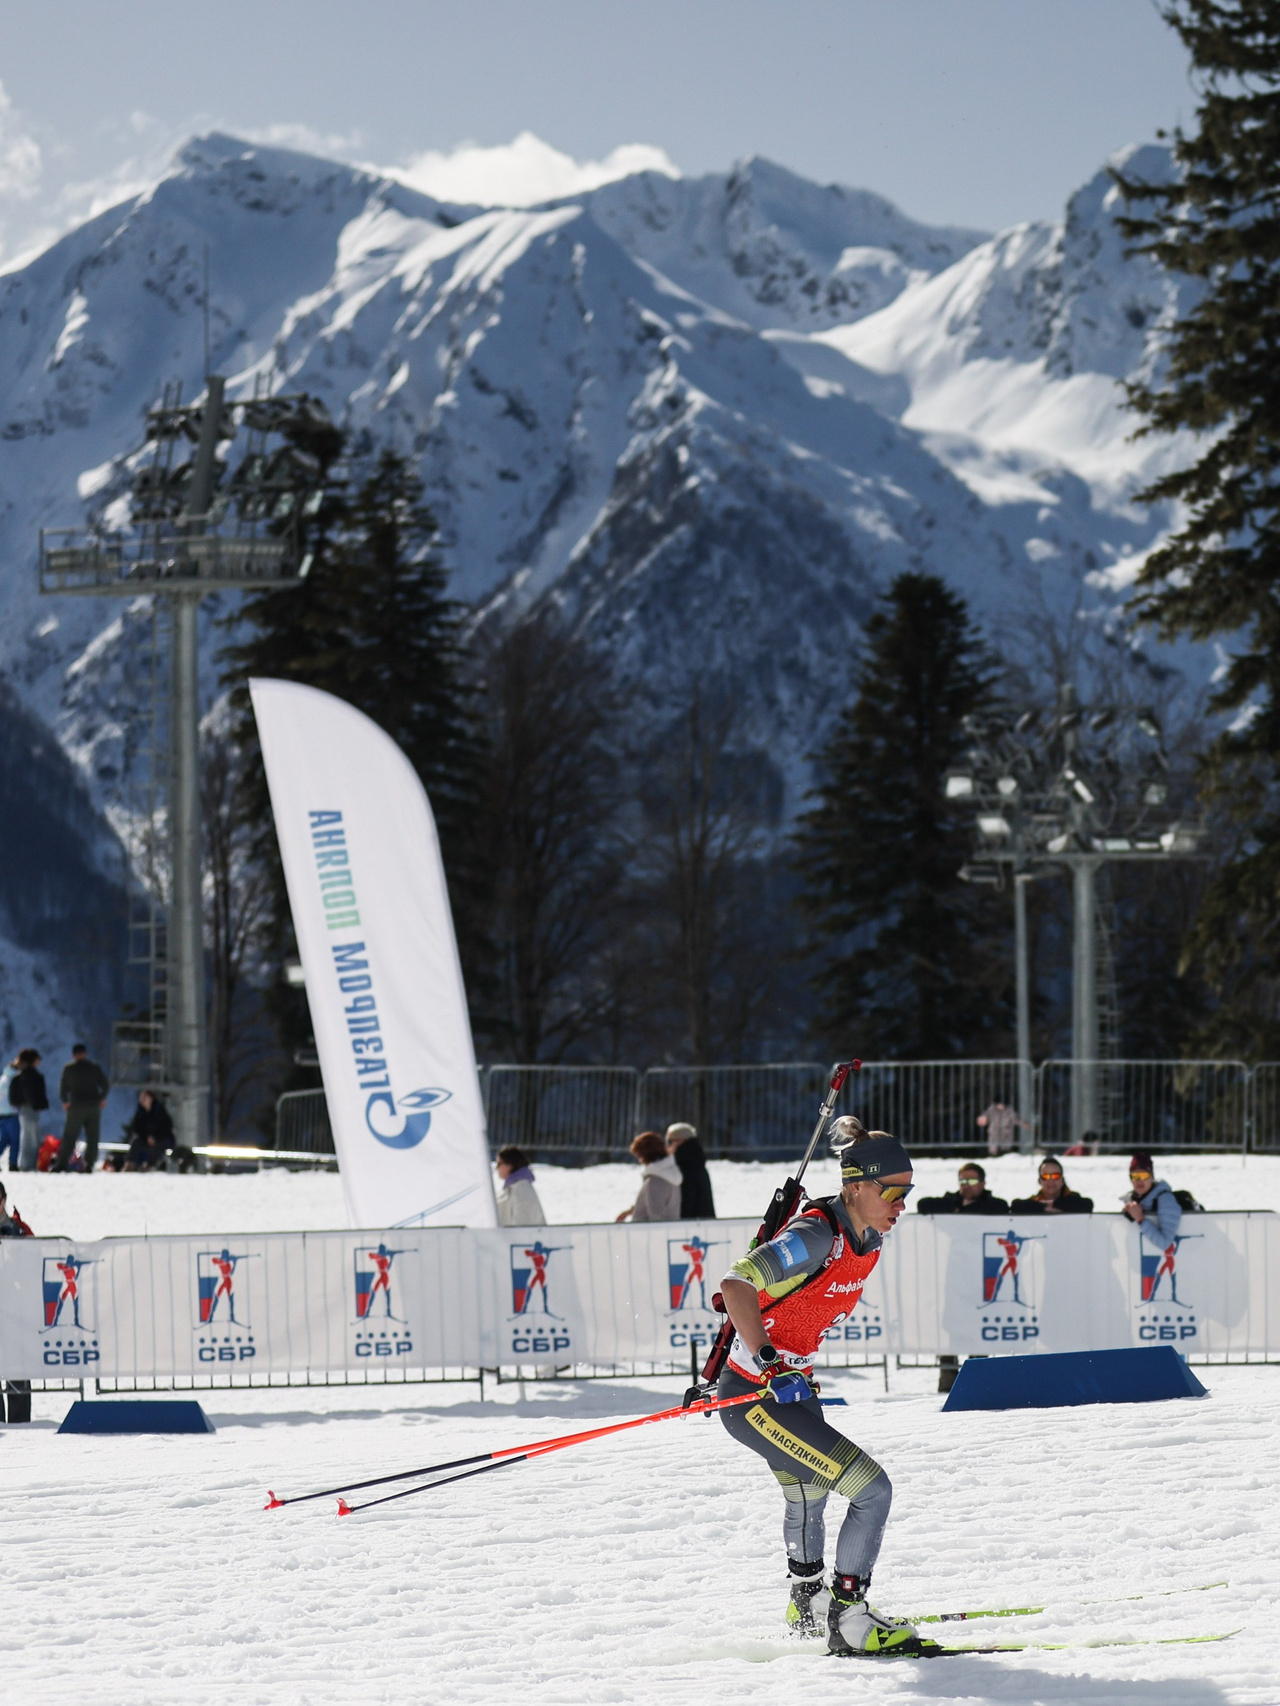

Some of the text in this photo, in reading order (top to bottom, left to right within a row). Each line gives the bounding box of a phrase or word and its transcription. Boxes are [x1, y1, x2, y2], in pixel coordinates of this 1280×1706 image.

[825, 1325, 882, 1341] СБР
[981, 1326, 1039, 1341] СБР
[1139, 1325, 1197, 1340] СБР
[354, 1342, 412, 1356] СБР
[512, 1337, 570, 1352] СБР
[43, 1349, 100, 1365] СБР
[198, 1346, 256, 1361] СБР
[752, 1412, 834, 1475] ЛК «НАСЕДКИНА»
